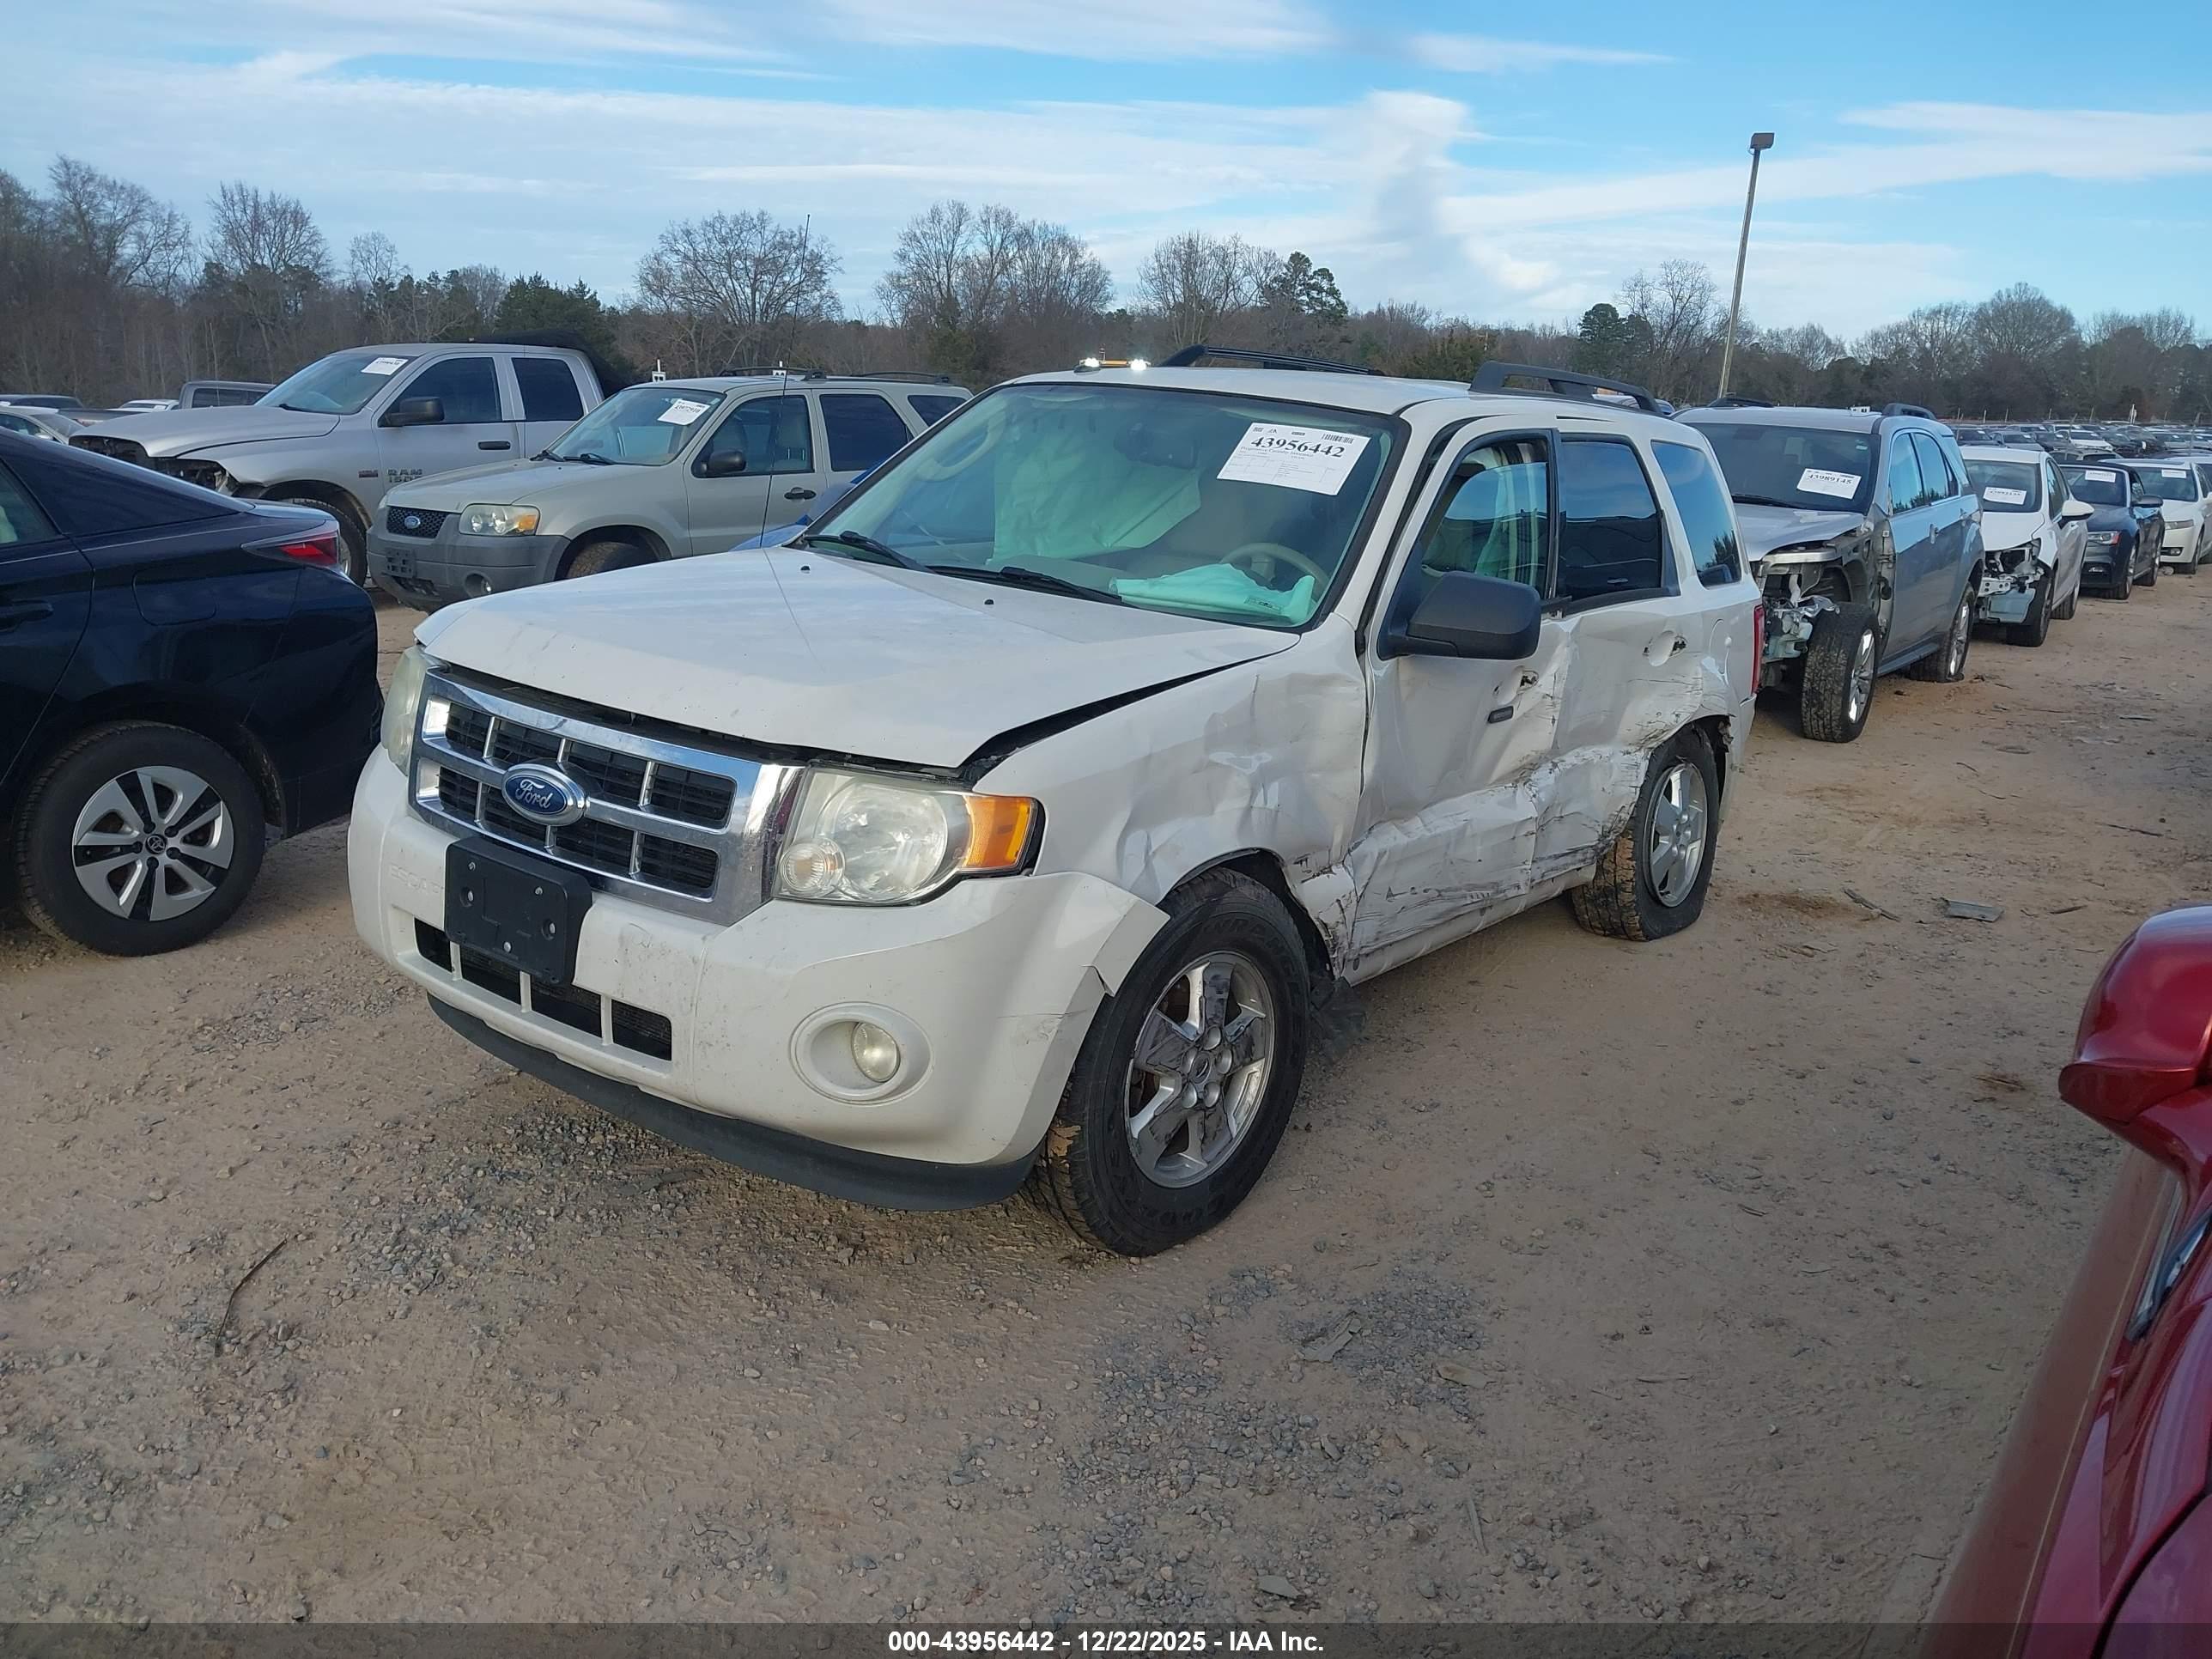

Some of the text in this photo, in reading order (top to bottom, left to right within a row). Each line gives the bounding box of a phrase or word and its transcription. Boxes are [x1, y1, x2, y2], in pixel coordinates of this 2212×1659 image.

[1251, 436, 1346, 458] 43956442
[1808, 474, 1852, 484] 43989145
[515, 779, 553, 808] Ford
